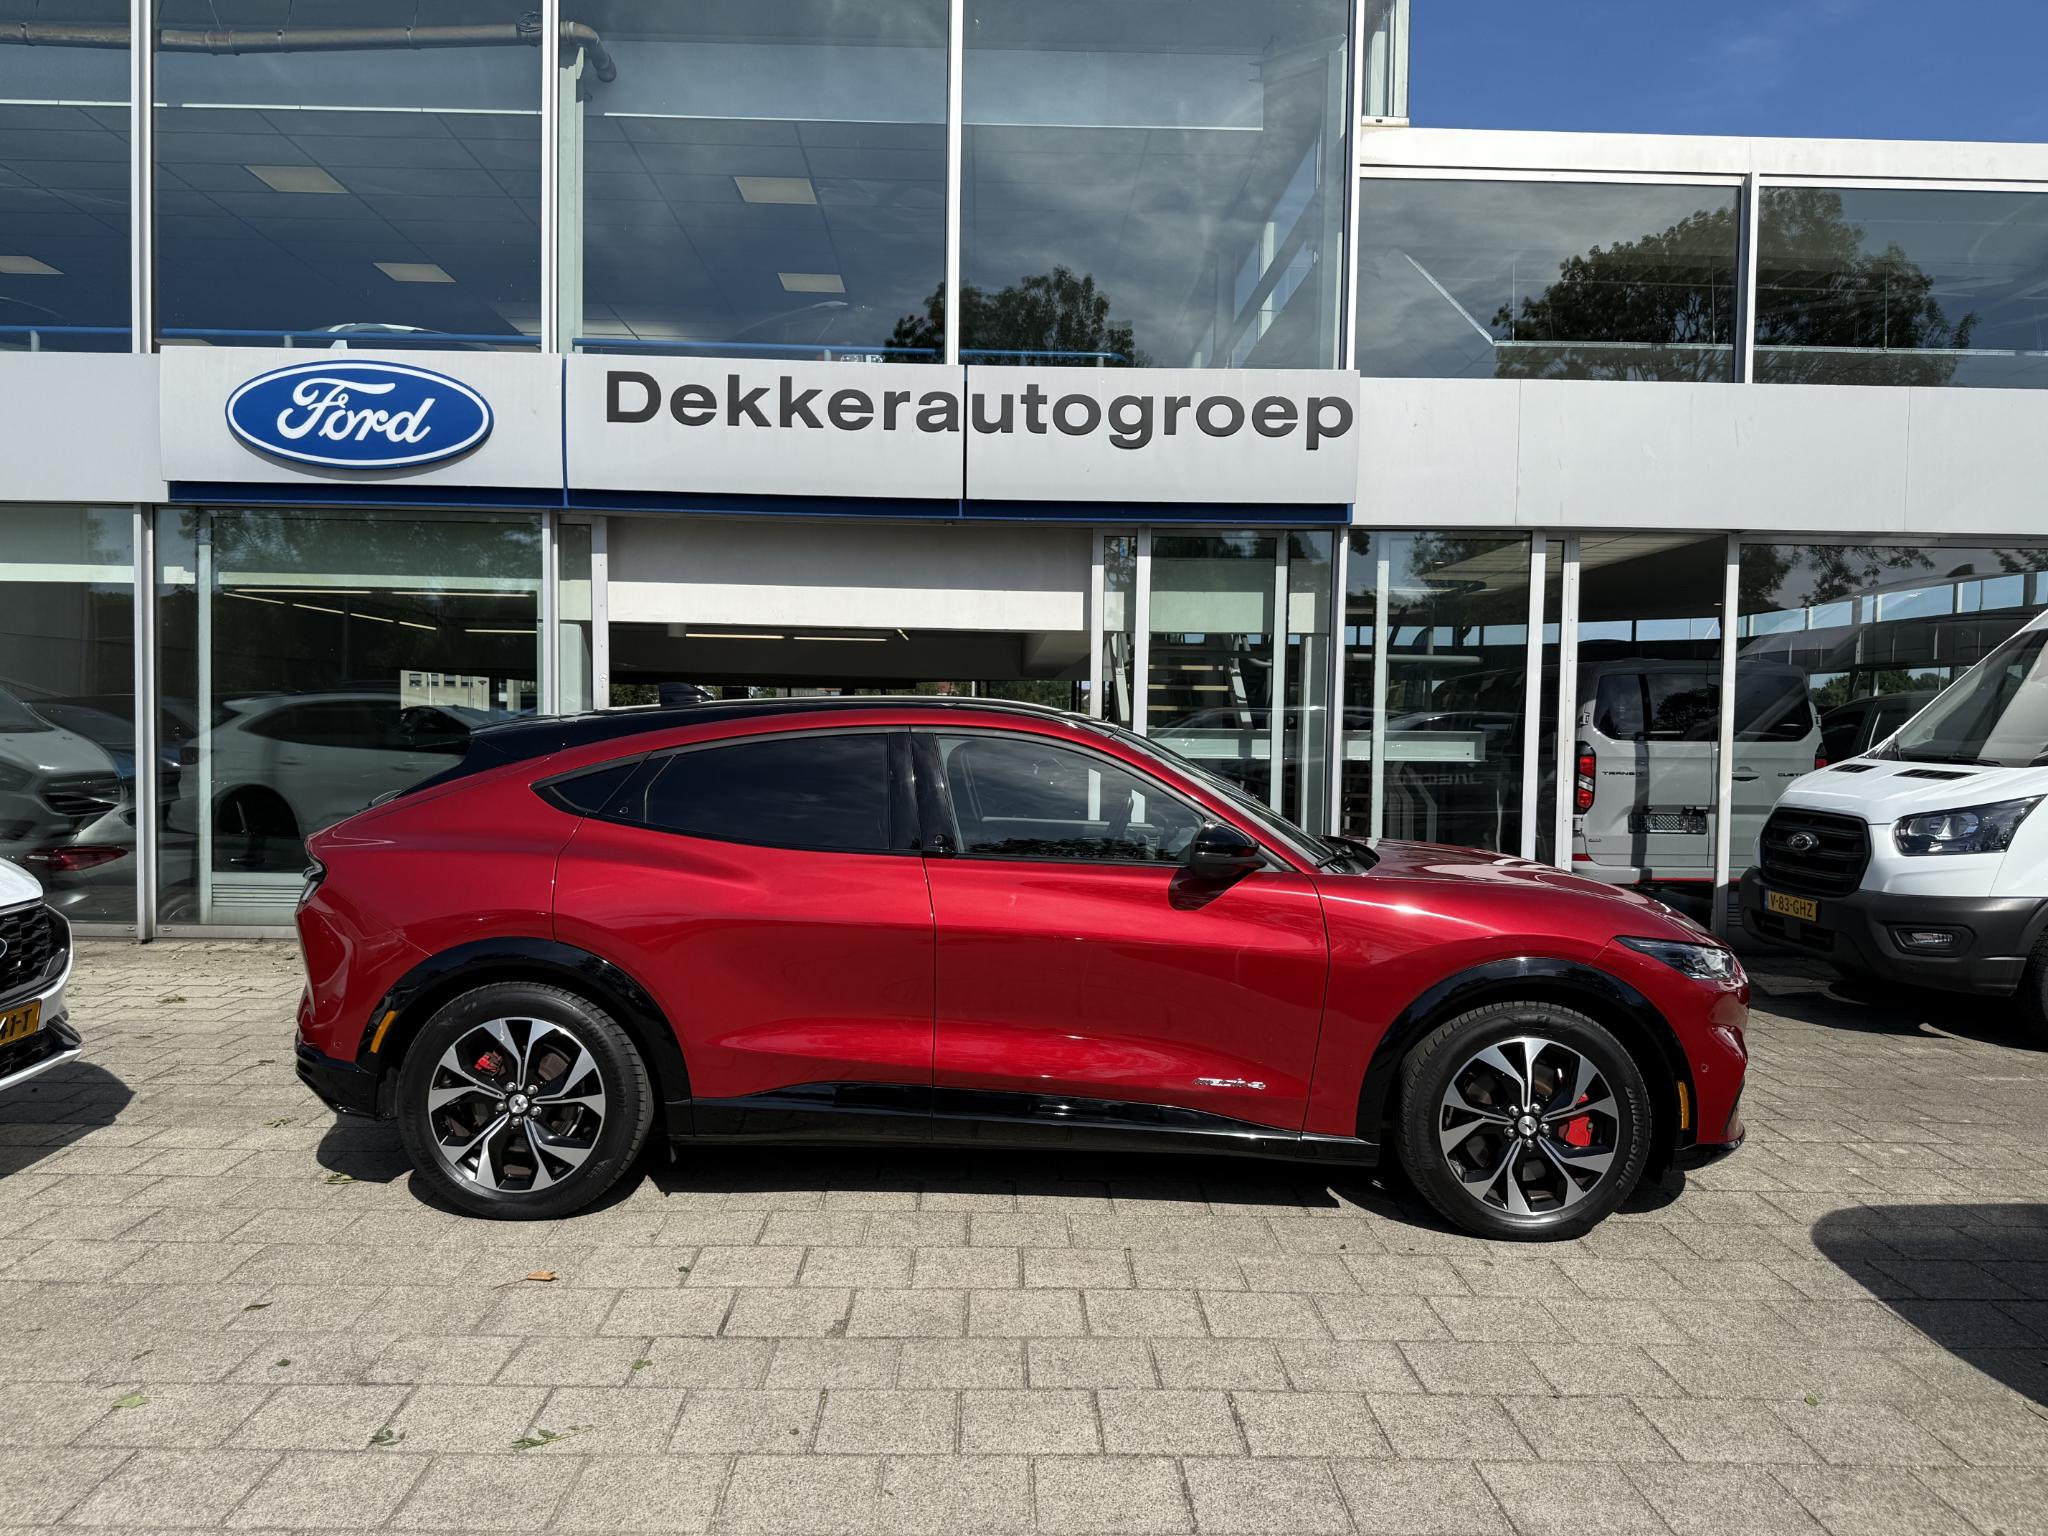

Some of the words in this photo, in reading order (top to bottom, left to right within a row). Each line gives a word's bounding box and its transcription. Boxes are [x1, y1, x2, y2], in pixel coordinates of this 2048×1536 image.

[276, 377, 437, 445] Ford
[606, 370, 1355, 450] Dekkerautogroep
[1769, 893, 1813, 918] V-83-GHZ
[1615, 1085, 1645, 1190] BRIDGESTONE
